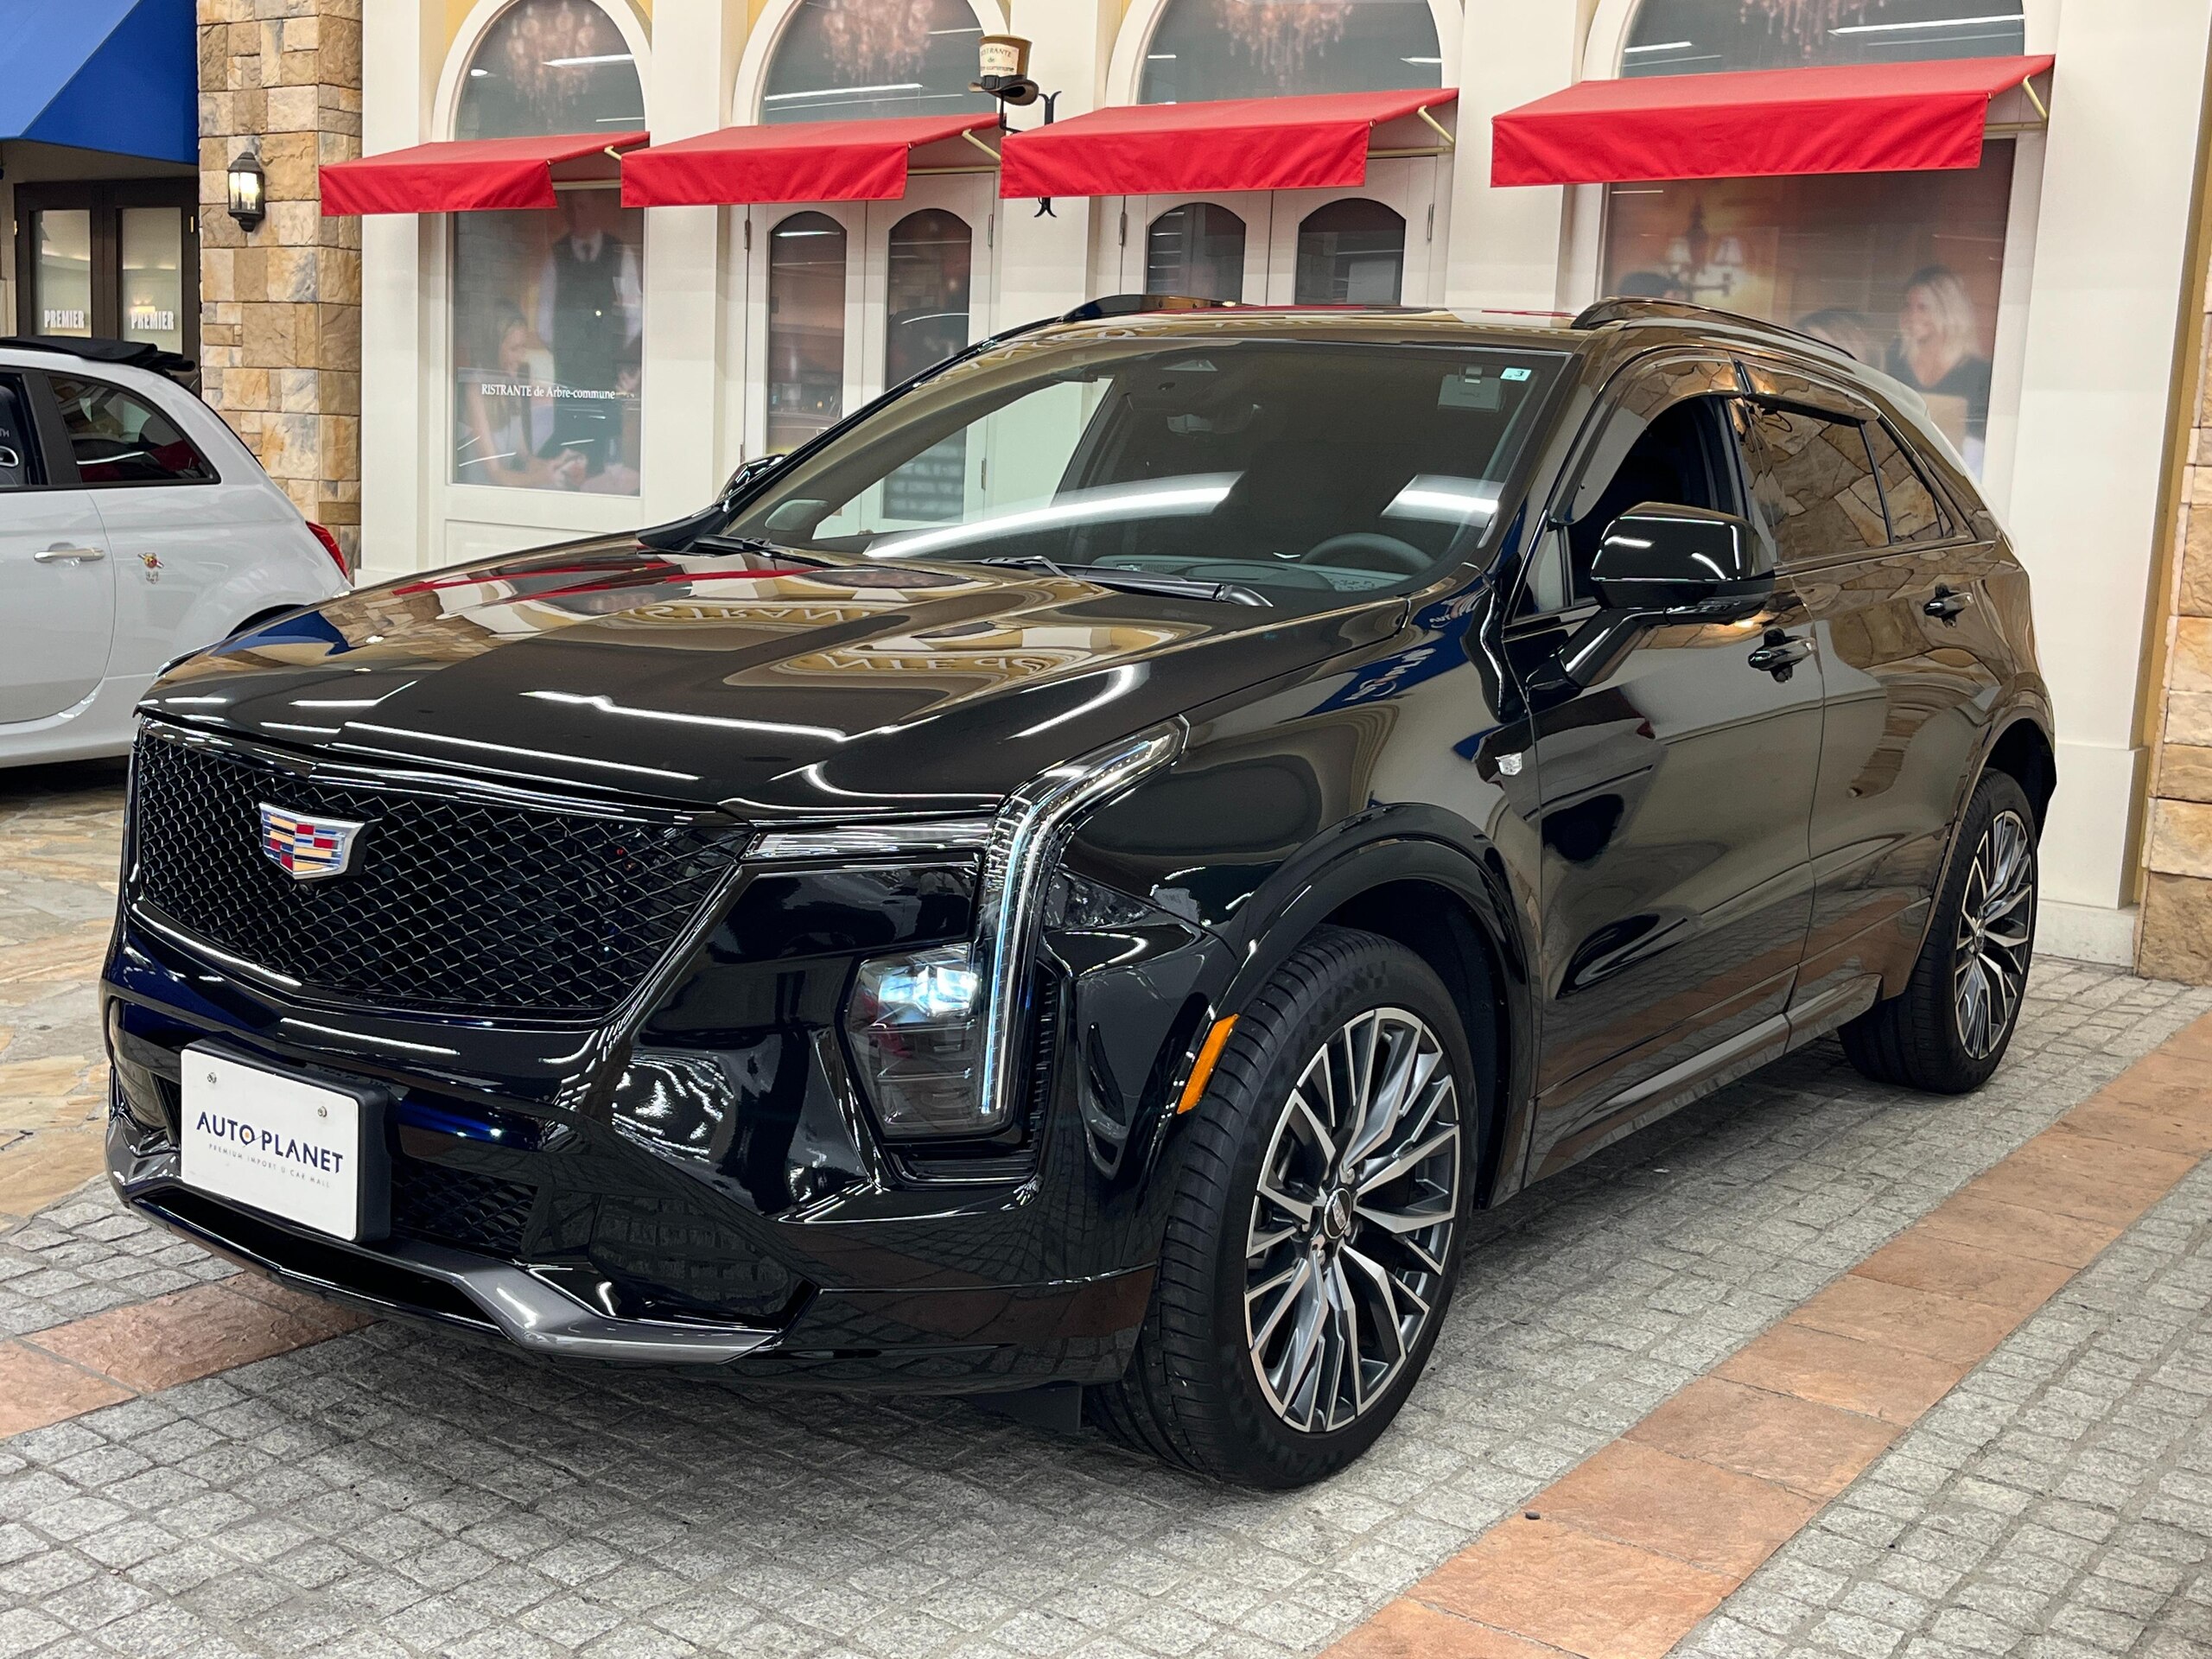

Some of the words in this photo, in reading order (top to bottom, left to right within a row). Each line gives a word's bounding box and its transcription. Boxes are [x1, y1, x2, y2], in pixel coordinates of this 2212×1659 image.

[44, 309, 85, 328] PREMIER
[130, 311, 174, 330] PREMIER
[481, 384, 531, 397] RISTRANTE
[534, 386, 544, 397] de
[546, 386, 615, 400] Arbre-commune
[196, 1111, 256, 1146] AUTO
[261, 1129, 343, 1174] PLANET
[208, 1143, 243, 1160] PREMIUM
[247, 1155, 276, 1171] IMPORT
[289, 1169, 305, 1180] CAR
[309, 1175, 330, 1188] MALL
